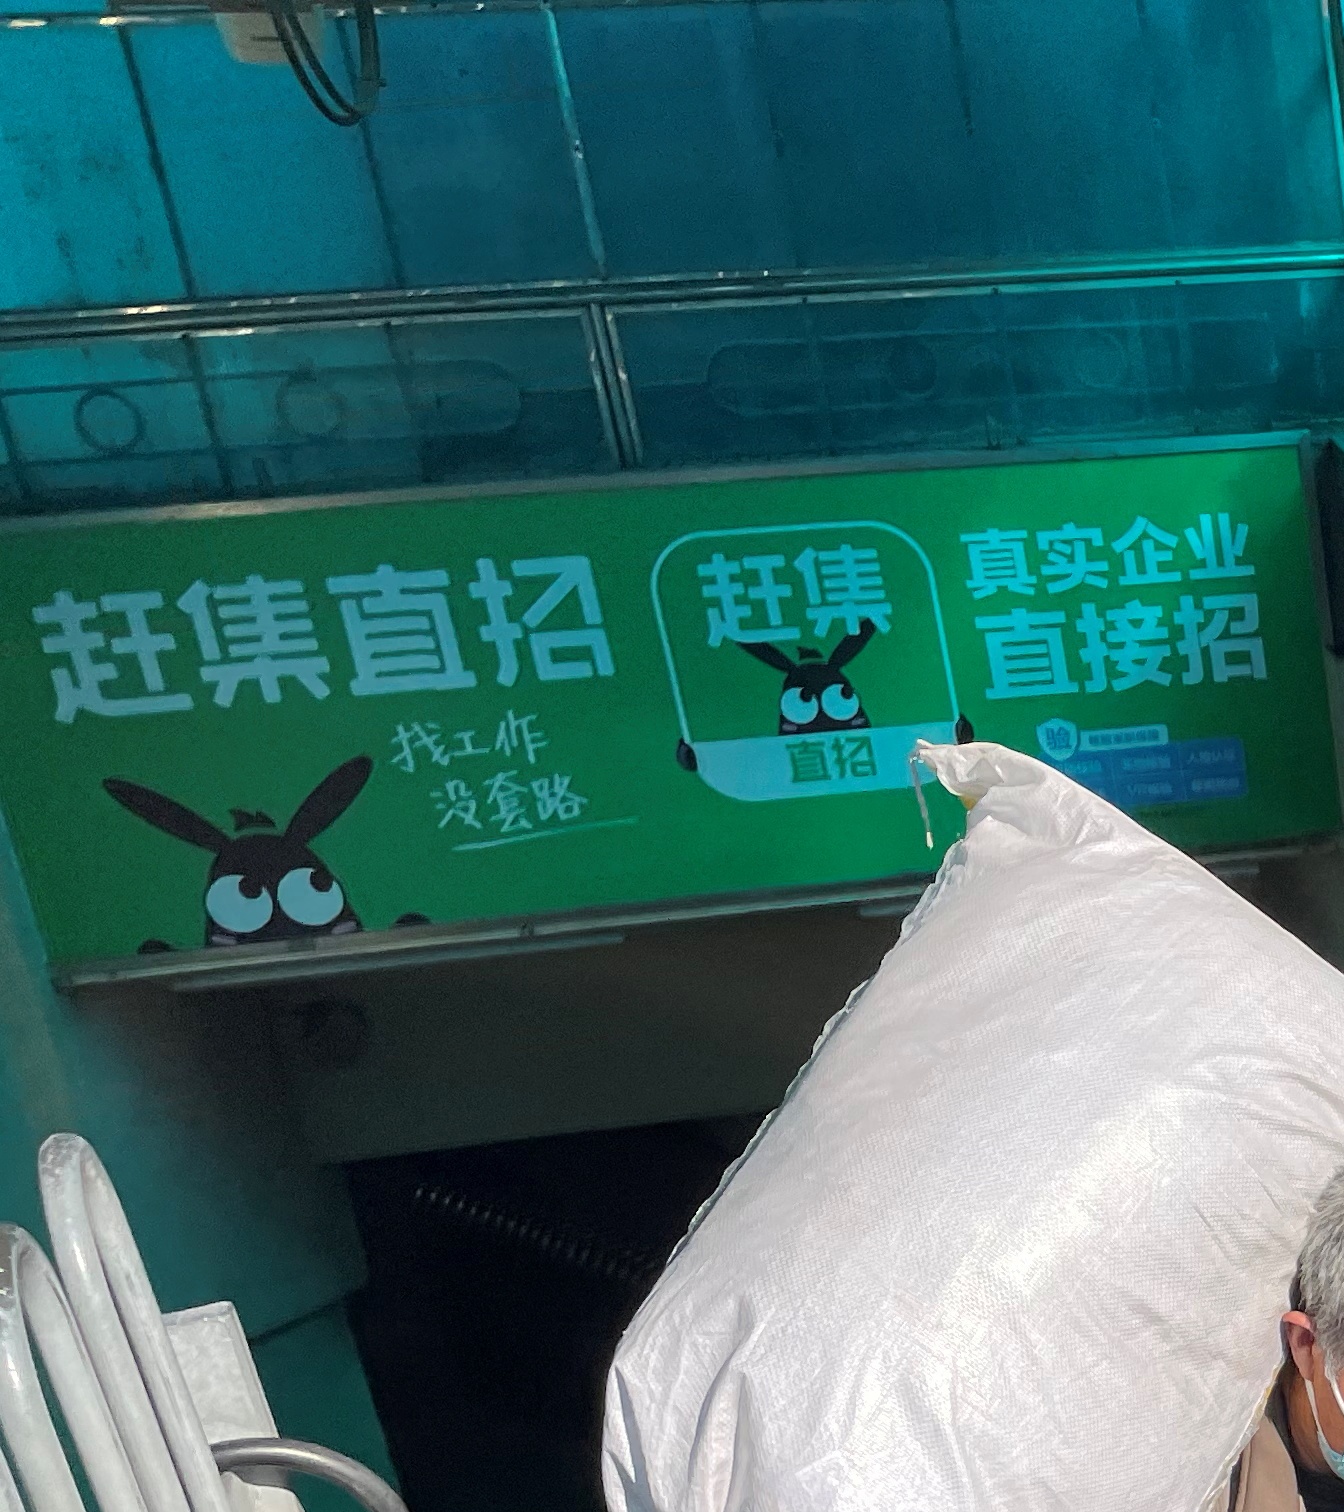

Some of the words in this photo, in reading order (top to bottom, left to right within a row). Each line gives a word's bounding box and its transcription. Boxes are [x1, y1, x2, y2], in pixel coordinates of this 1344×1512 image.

[960, 512, 1257, 599] 真实企业
[697, 544, 893, 647] 赶集
[32, 555, 616, 723] 赶集直招
[975, 593, 1268, 700] 直接招
[390, 709, 548, 772] 找工作
[786, 736, 878, 783] 直招
[1046, 726, 1073, 750] 验
[430, 769, 589, 832] 没套路
